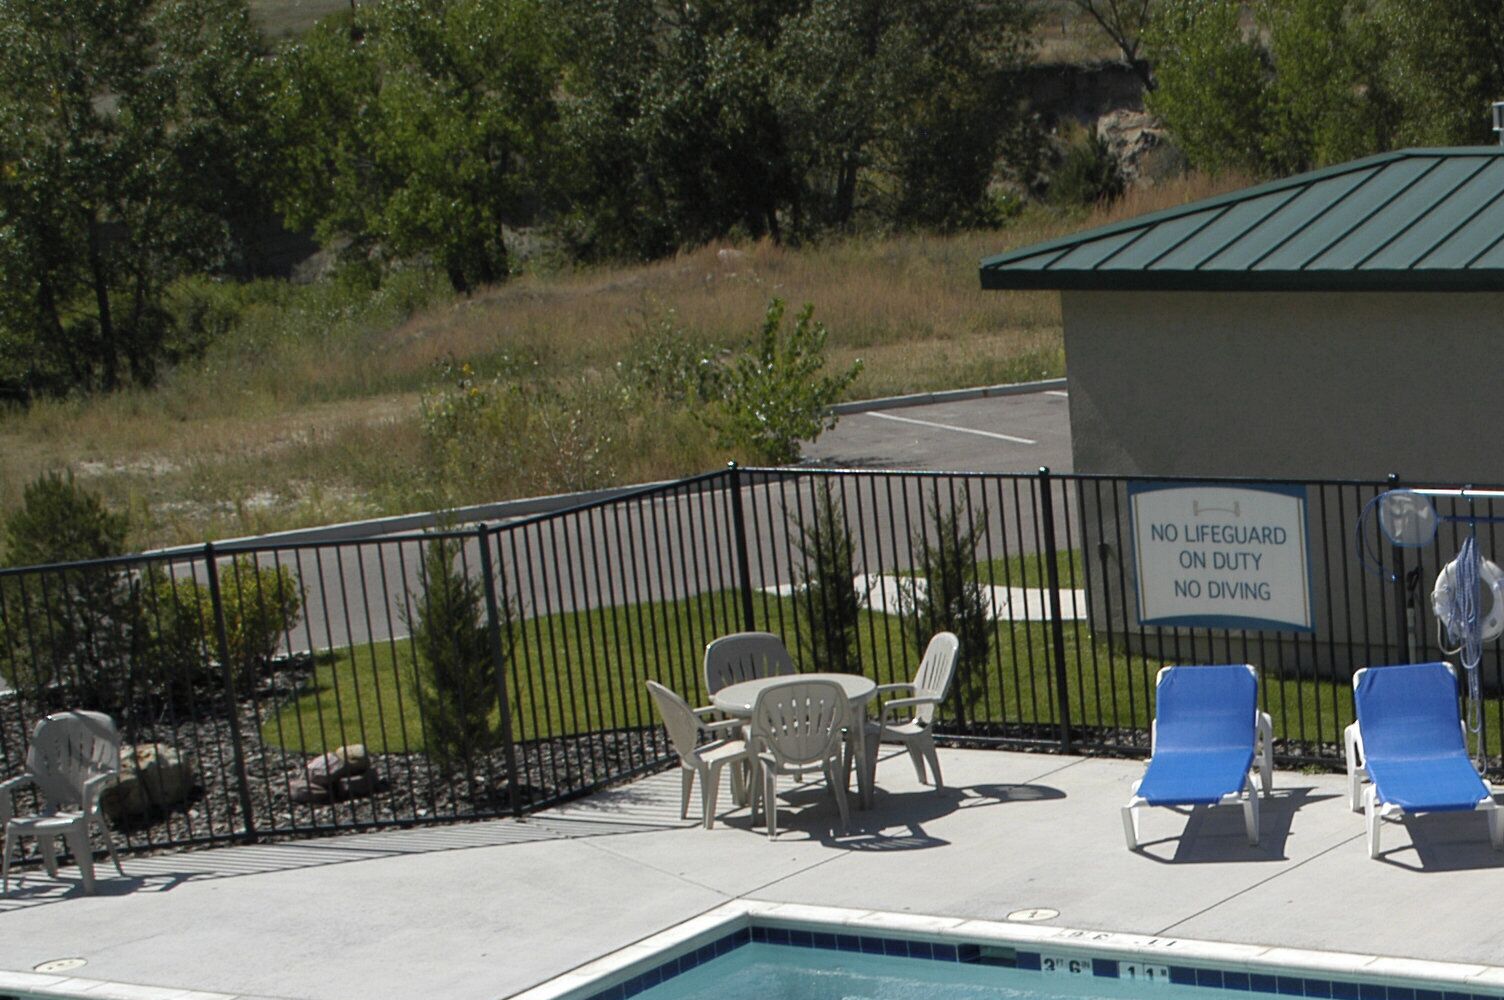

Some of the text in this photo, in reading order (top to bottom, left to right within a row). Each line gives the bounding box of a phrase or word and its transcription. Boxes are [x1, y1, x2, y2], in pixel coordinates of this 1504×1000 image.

[1151, 523, 1287, 545] NO LIFEGUARD
[1179, 550, 1262, 571] ON DUTY
[1174, 580, 1271, 601] NO DIVING
